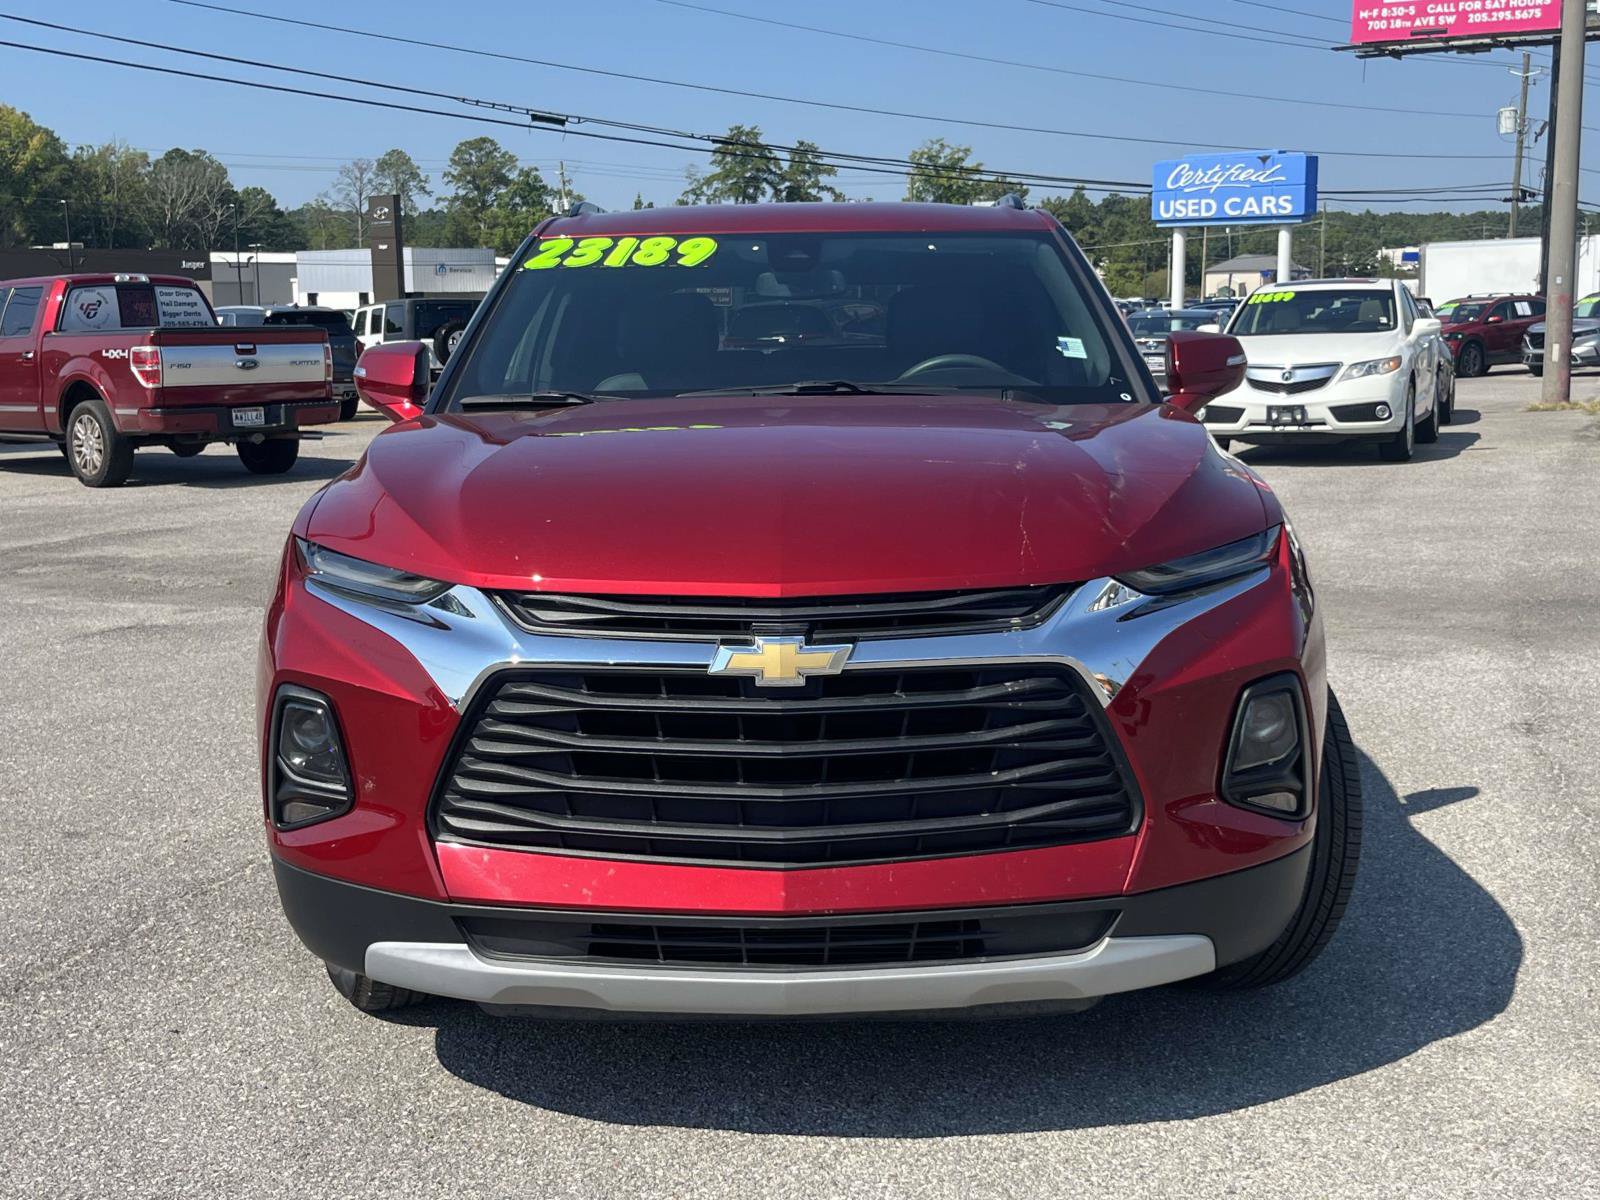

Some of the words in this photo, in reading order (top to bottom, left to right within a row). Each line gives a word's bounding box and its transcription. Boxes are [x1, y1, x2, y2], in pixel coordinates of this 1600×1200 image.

[1360, 8, 1379, 19] M-F
[1381, 5, 1416, 18] 8:30-5
[1426, 3, 1456, 14] CALL
[1458, 1, 1482, 12] FOR
[1484, 0, 1507, 10] SAT
[1508, 0, 1552, 8] HOURS
[1367, 20, 1388, 31] 700
[1413, 15, 1436, 27] AVE
[1438, 14, 1457, 25] SW
[1467, 8, 1543, 24] 205.295.5675
[1166, 162, 1287, 194] Certified
[1159, 198, 1218, 218] USED
[1223, 194, 1294, 217] CARS
[523, 236, 719, 270] 23189
[175, 290, 193, 298] Dings
